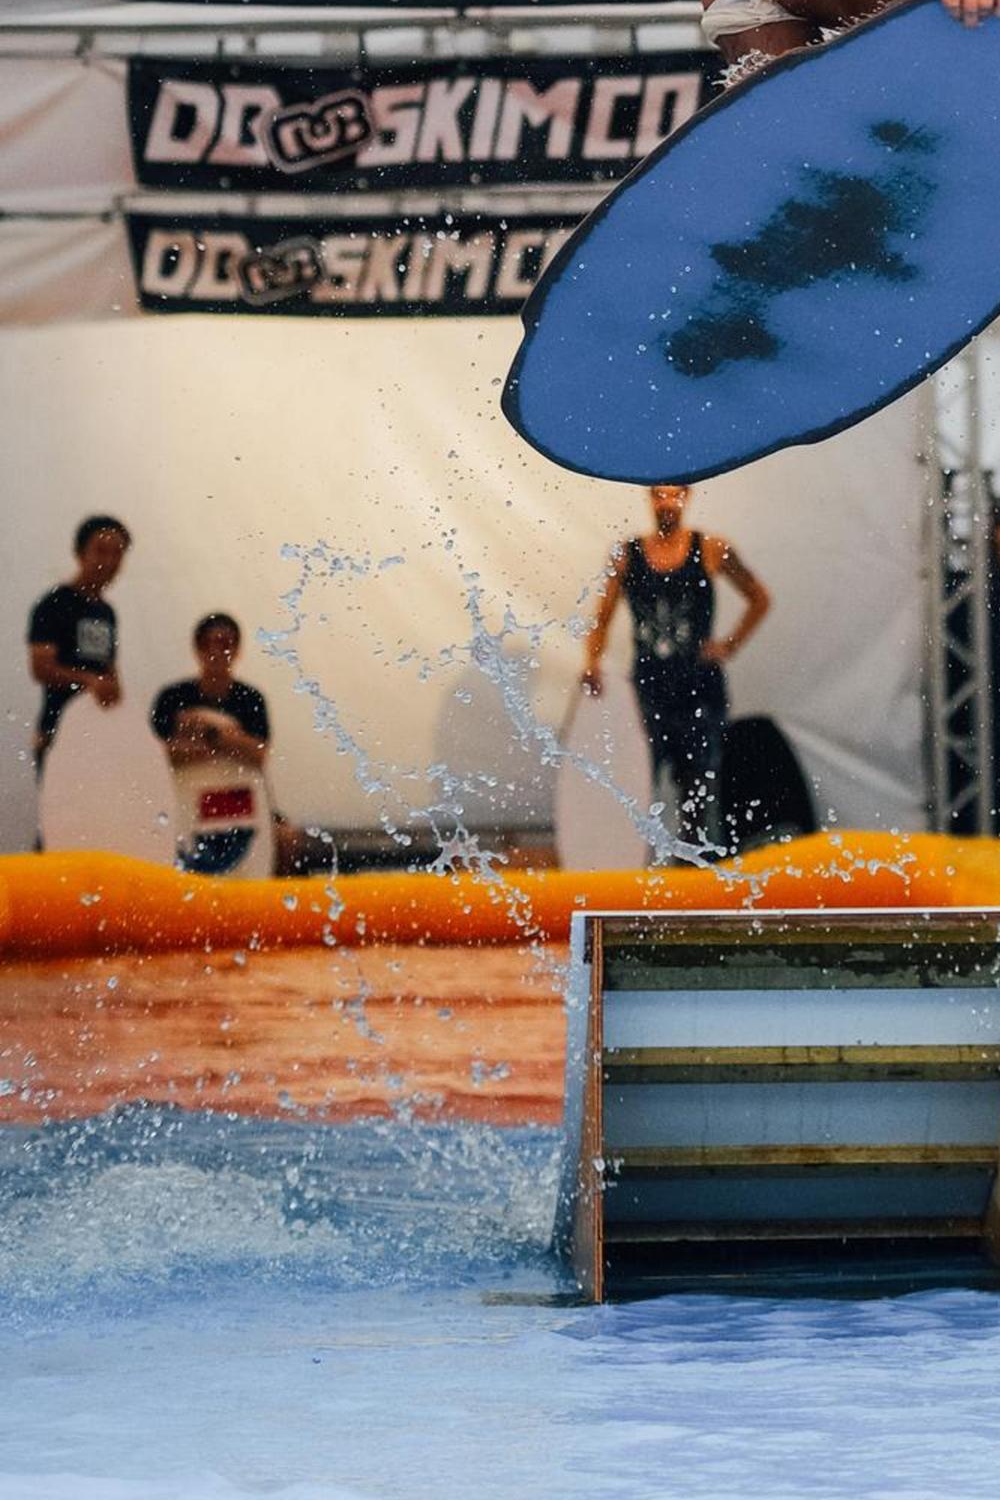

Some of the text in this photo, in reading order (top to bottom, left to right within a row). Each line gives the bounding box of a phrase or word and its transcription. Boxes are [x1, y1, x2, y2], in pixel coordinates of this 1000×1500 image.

[144, 80, 282, 166] DB
[355, 76, 582, 167] SKIM
[141, 231, 252, 301] DB
[310, 229, 498, 304] SKIM
